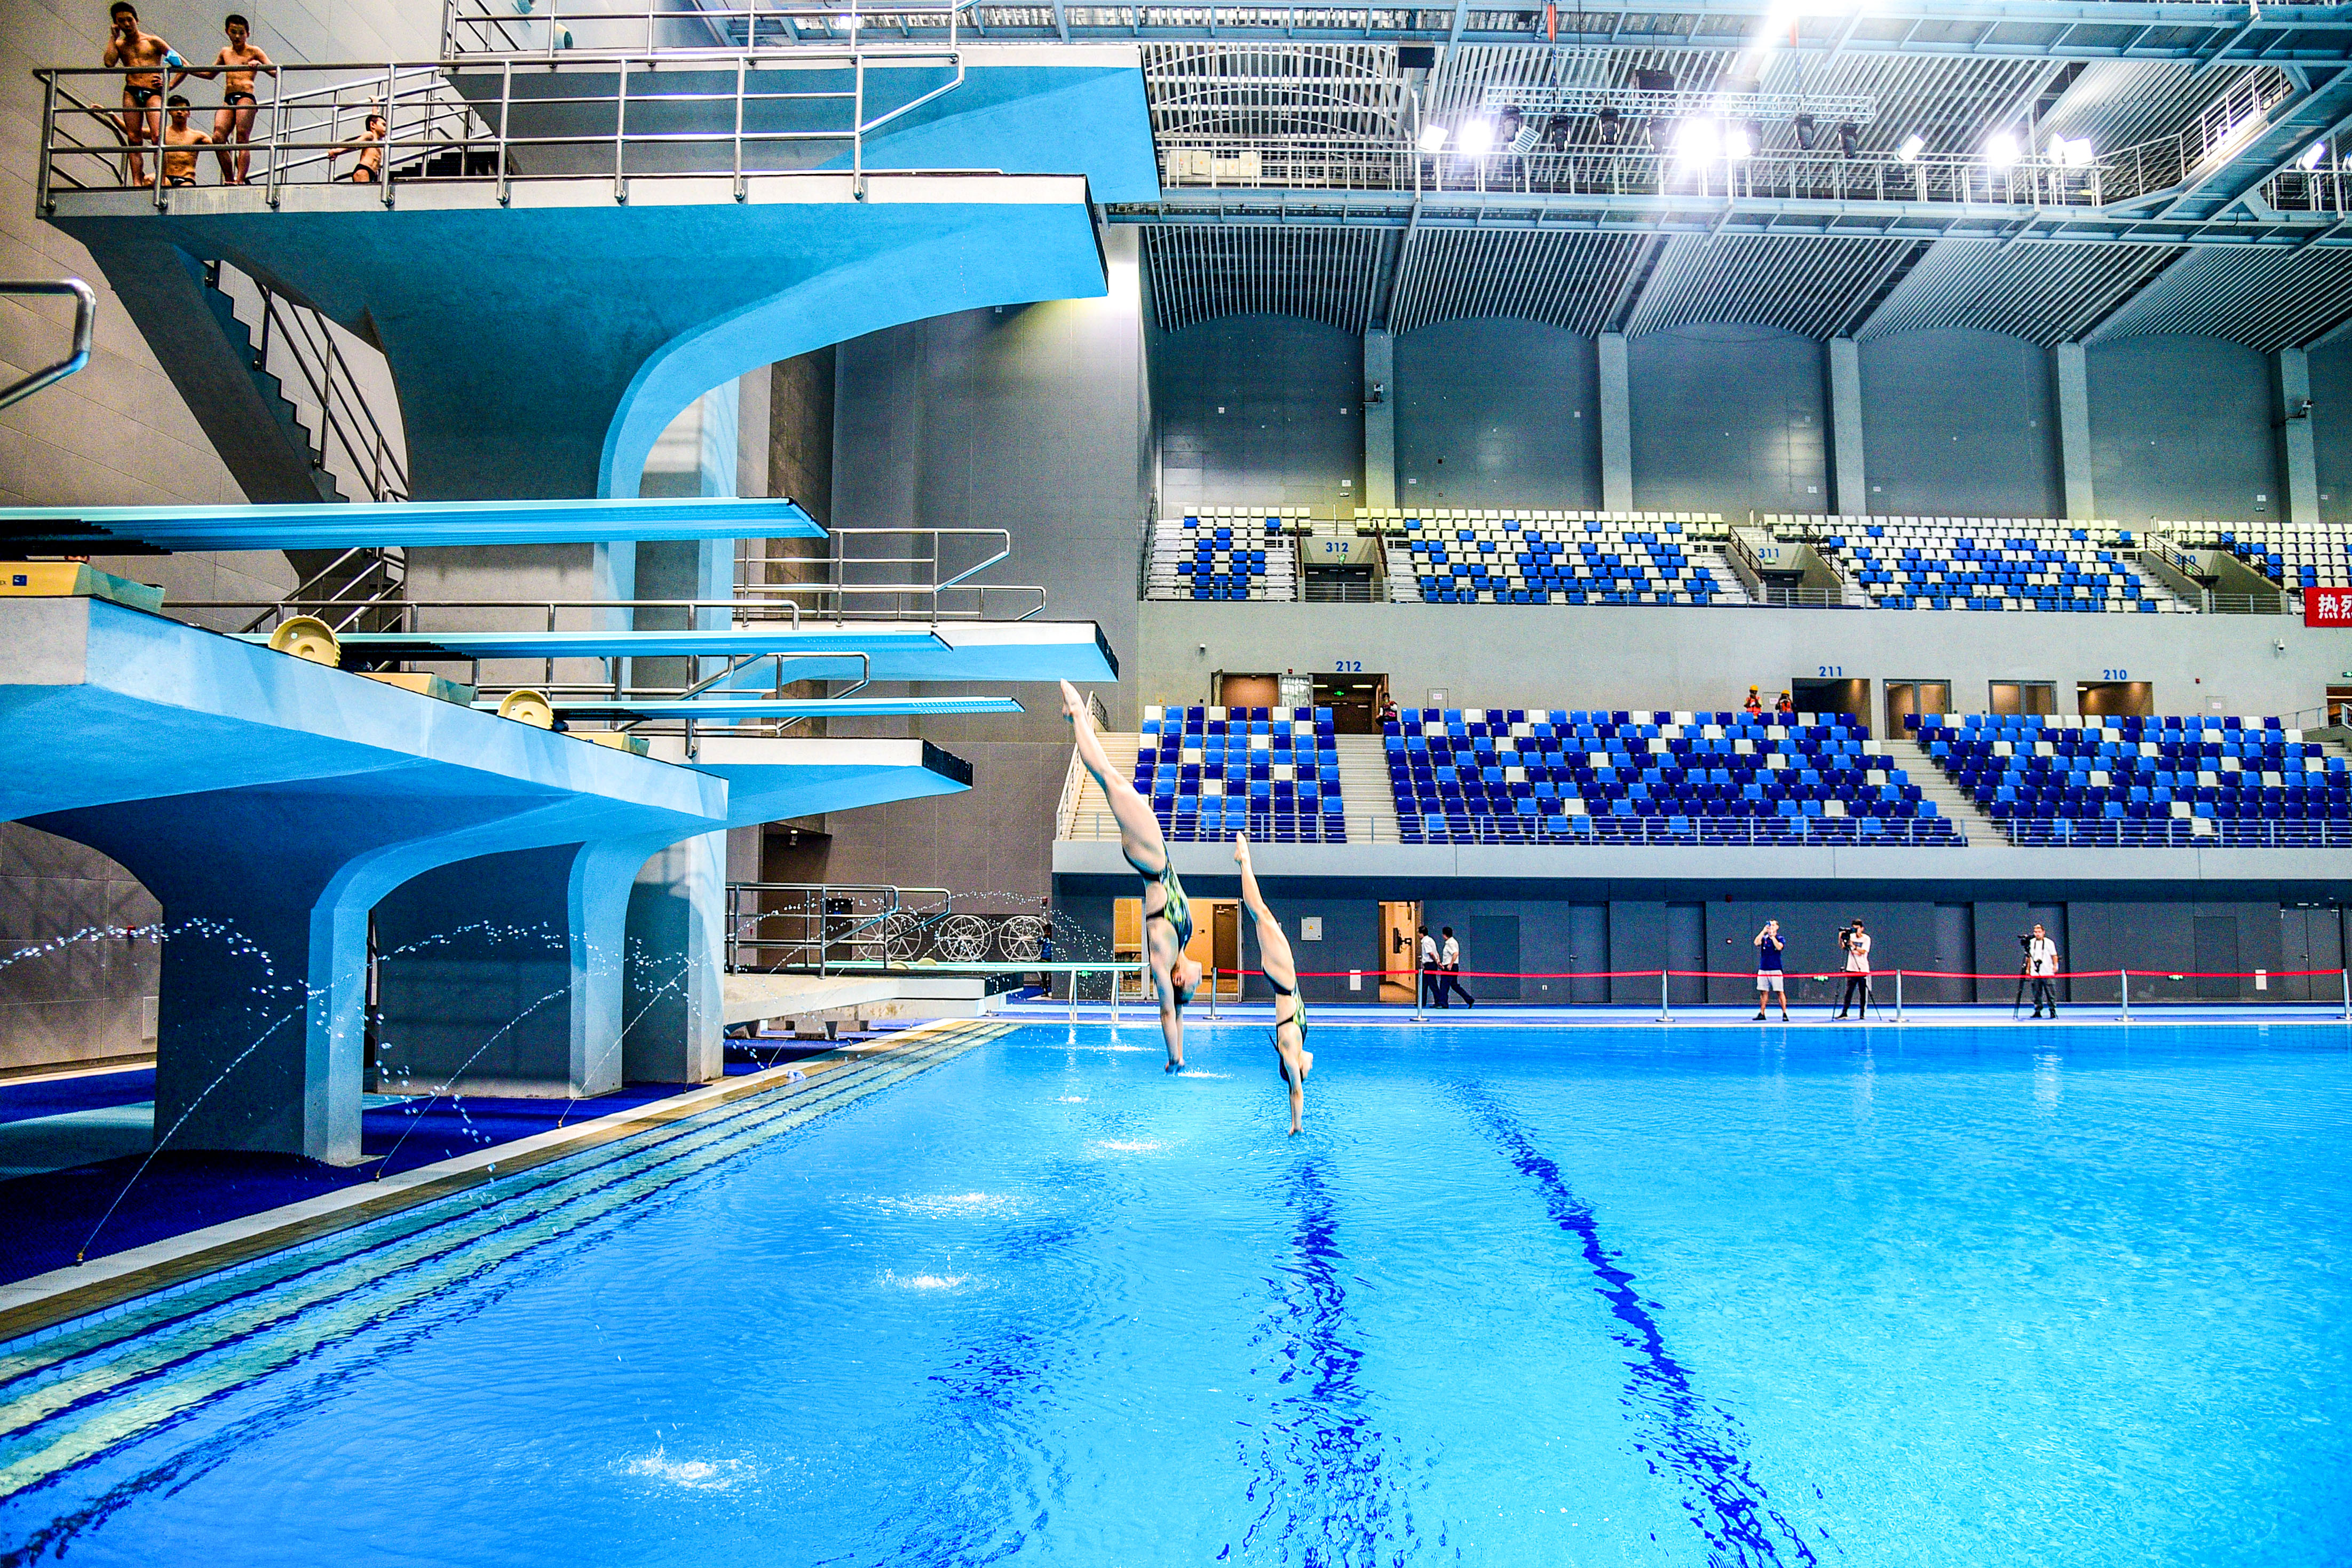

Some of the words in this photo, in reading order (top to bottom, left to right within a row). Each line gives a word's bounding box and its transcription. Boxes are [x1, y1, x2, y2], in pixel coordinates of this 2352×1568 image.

[1326, 542, 1349, 552] 312
[1758, 548, 1779, 558] 311
[1336, 661, 1362, 671] 212
[1819, 666, 1842, 677] 211
[2103, 669, 2127, 680] 210
